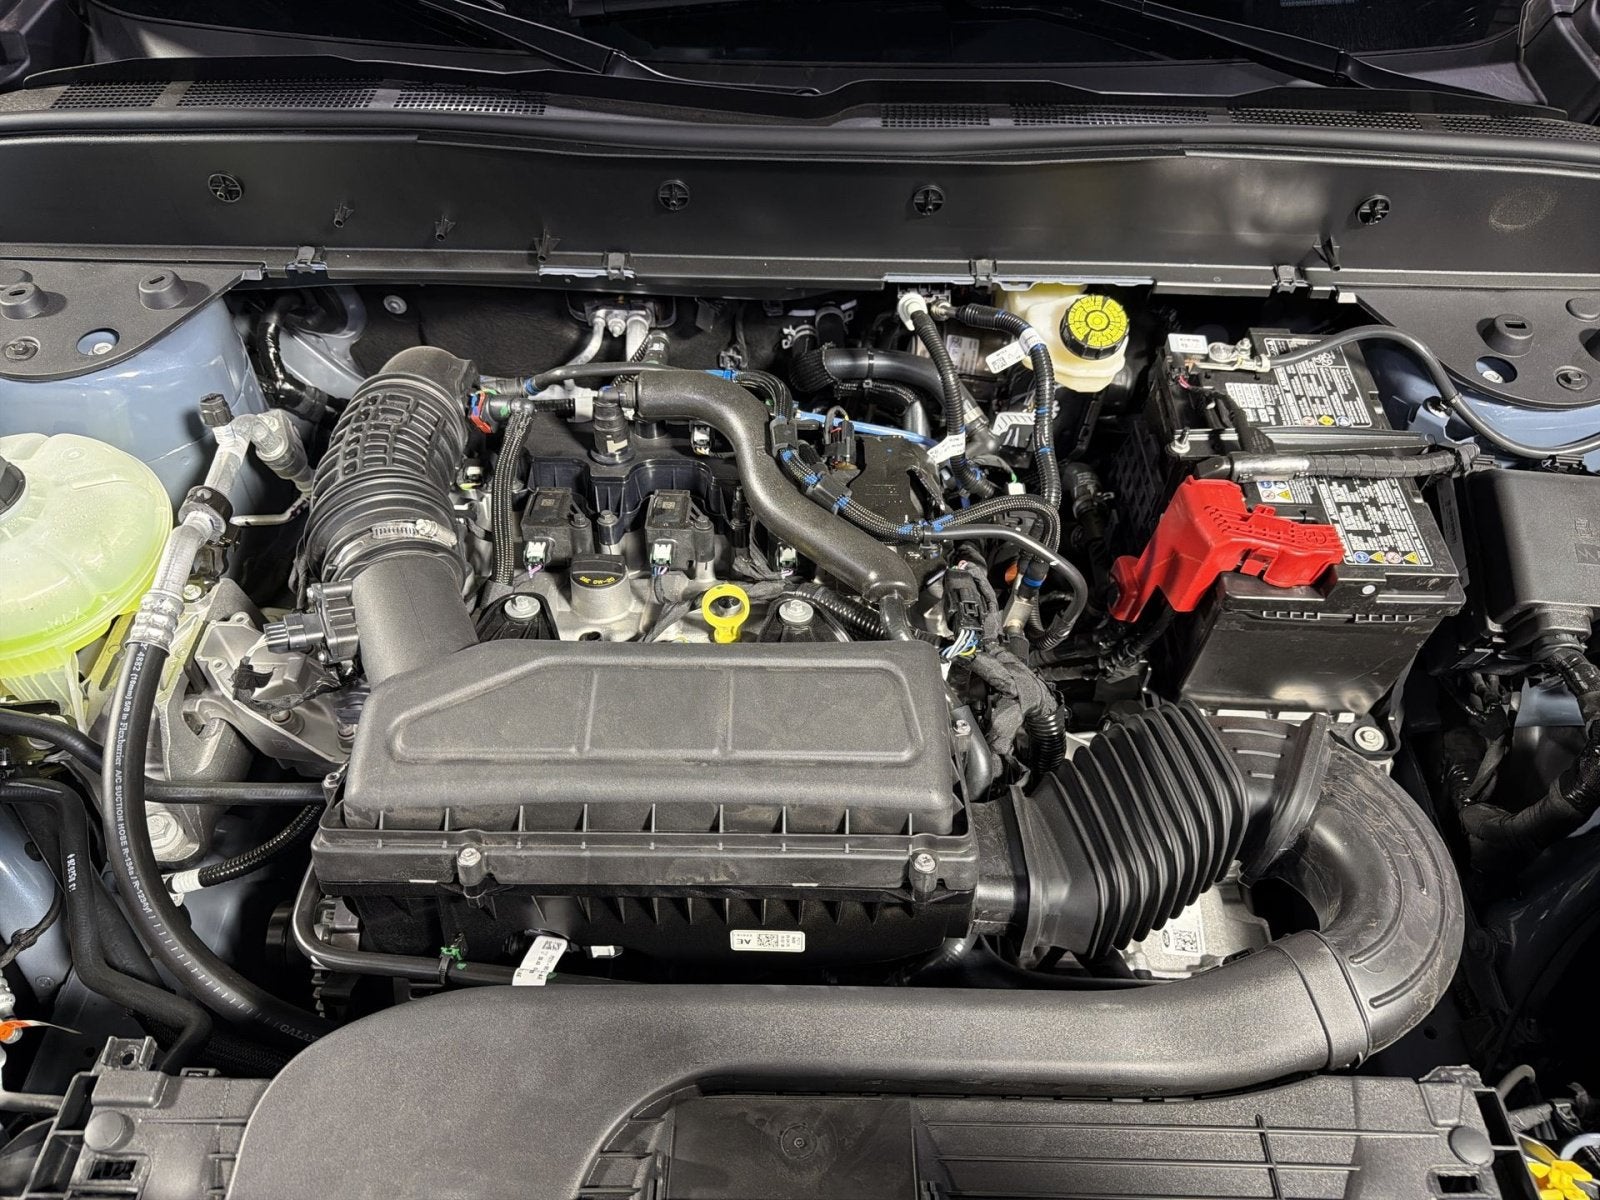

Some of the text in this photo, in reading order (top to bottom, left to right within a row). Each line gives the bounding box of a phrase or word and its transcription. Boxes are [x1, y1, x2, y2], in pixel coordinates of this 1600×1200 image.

[132, 651, 145, 671] 4882
[115, 722, 128, 766] Flexbarrier
[115, 785, 124, 822] SUCTION
[118, 823, 128, 847] HOSE
